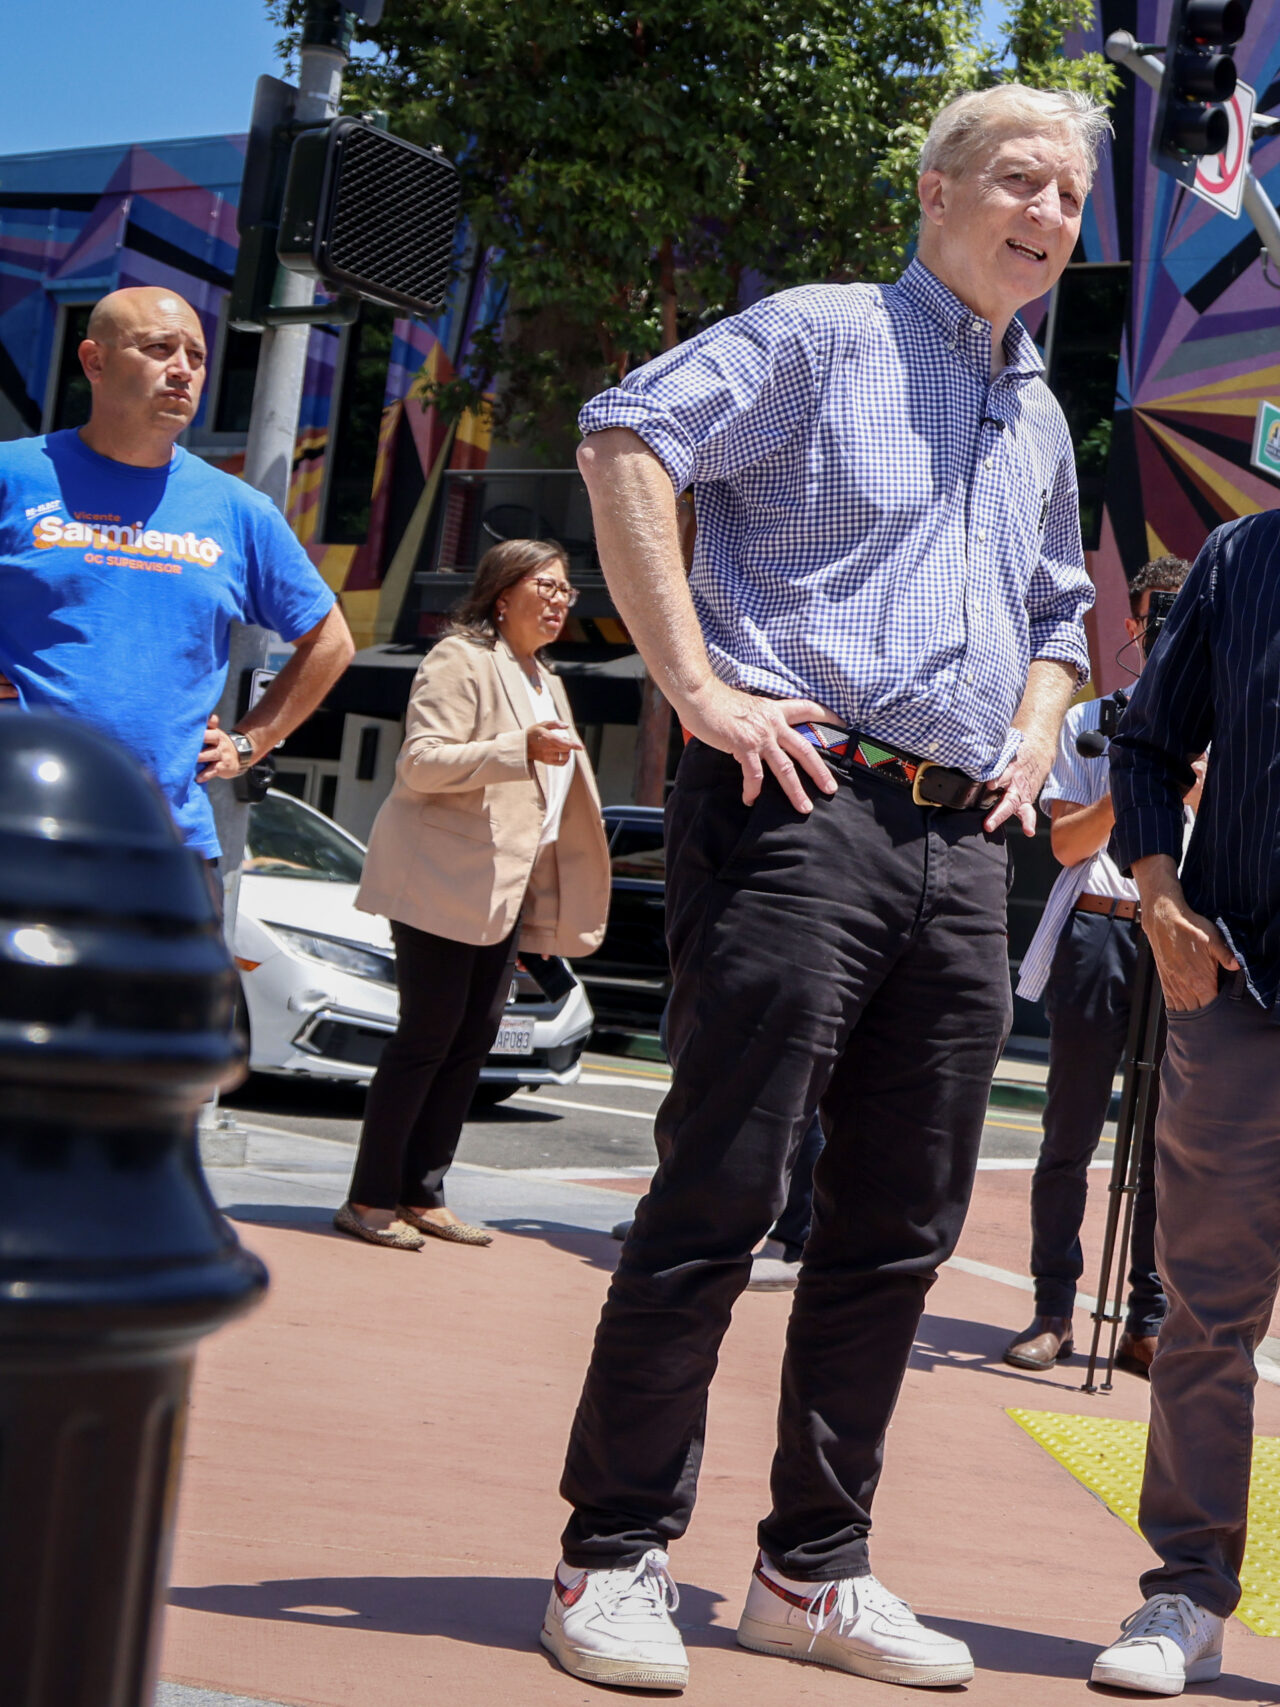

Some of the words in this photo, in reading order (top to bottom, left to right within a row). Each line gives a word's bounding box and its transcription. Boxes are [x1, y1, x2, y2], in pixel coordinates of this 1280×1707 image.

[74, 511, 121, 522] Vicente
[38, 515, 222, 565] Sarmiento
[84, 553, 104, 564] OC
[106, 554, 182, 574] SUPERVISOR
[495, 1031, 530, 1049] AP083
